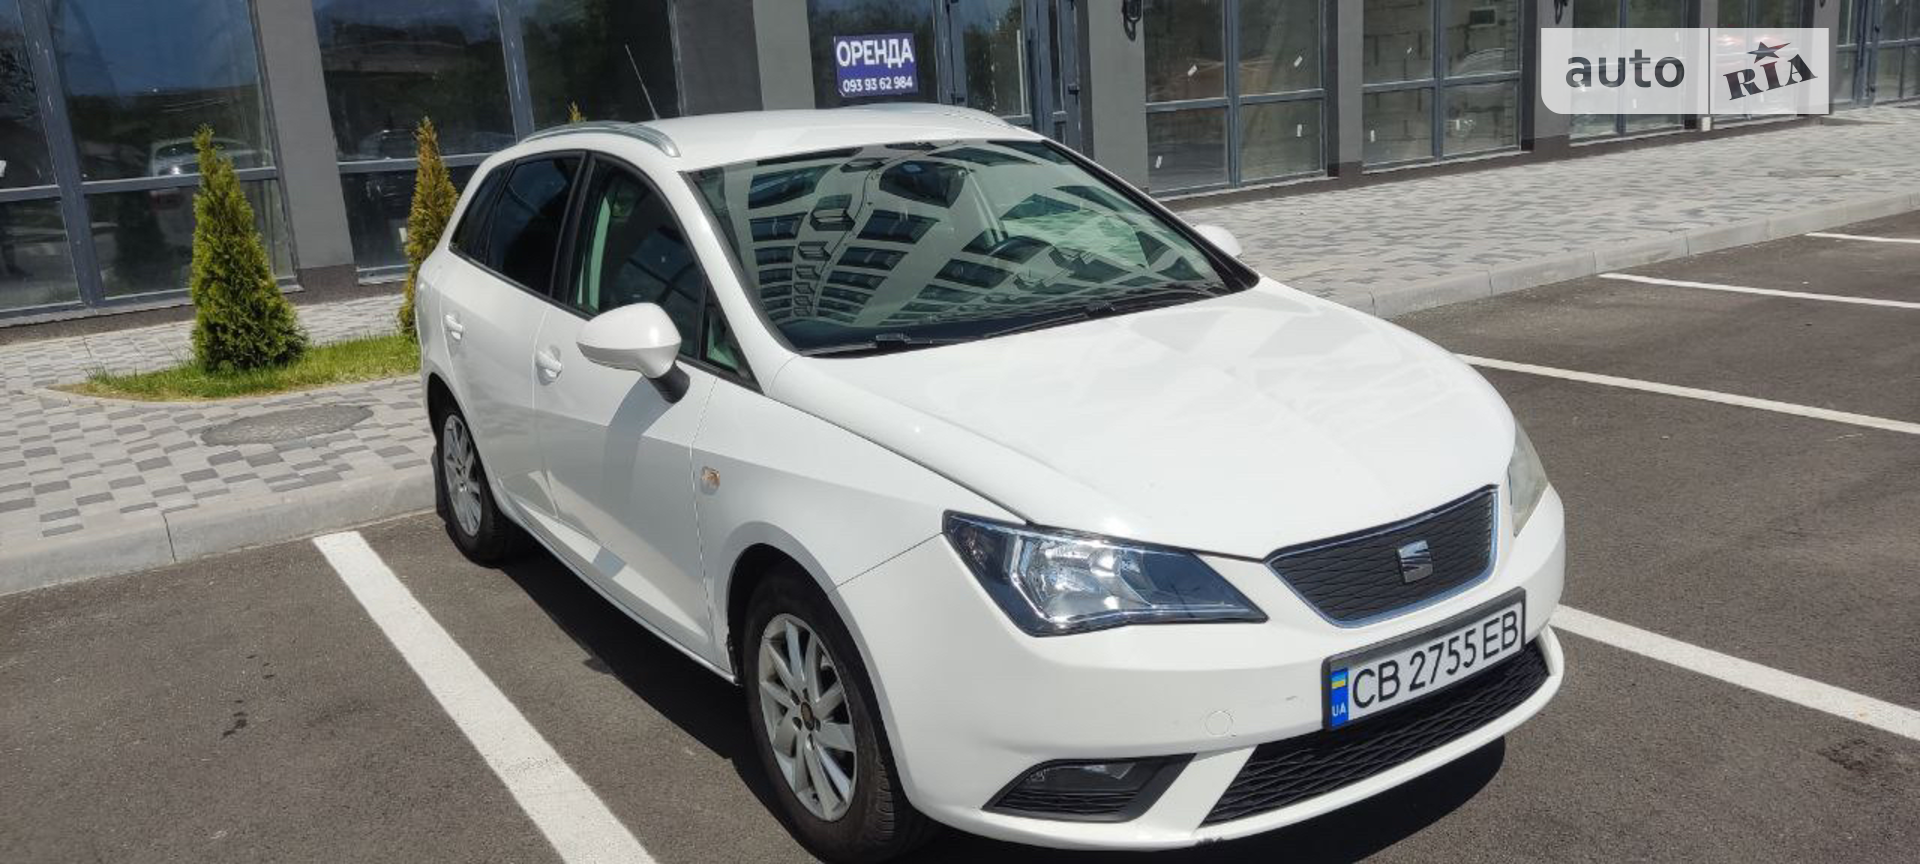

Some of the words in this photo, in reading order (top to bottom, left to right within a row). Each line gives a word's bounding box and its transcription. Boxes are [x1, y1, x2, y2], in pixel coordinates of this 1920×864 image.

[836, 38, 914, 68] ОРЕНДА
[842, 79, 863, 92] 093
[864, 78, 877, 91] 93
[879, 77, 892, 90] 62
[894, 76, 913, 89] 984
[1353, 659, 1400, 708] CB
[1409, 628, 1476, 692] 2755
[1483, 610, 1518, 660] EB
[1332, 702, 1347, 717] UA
